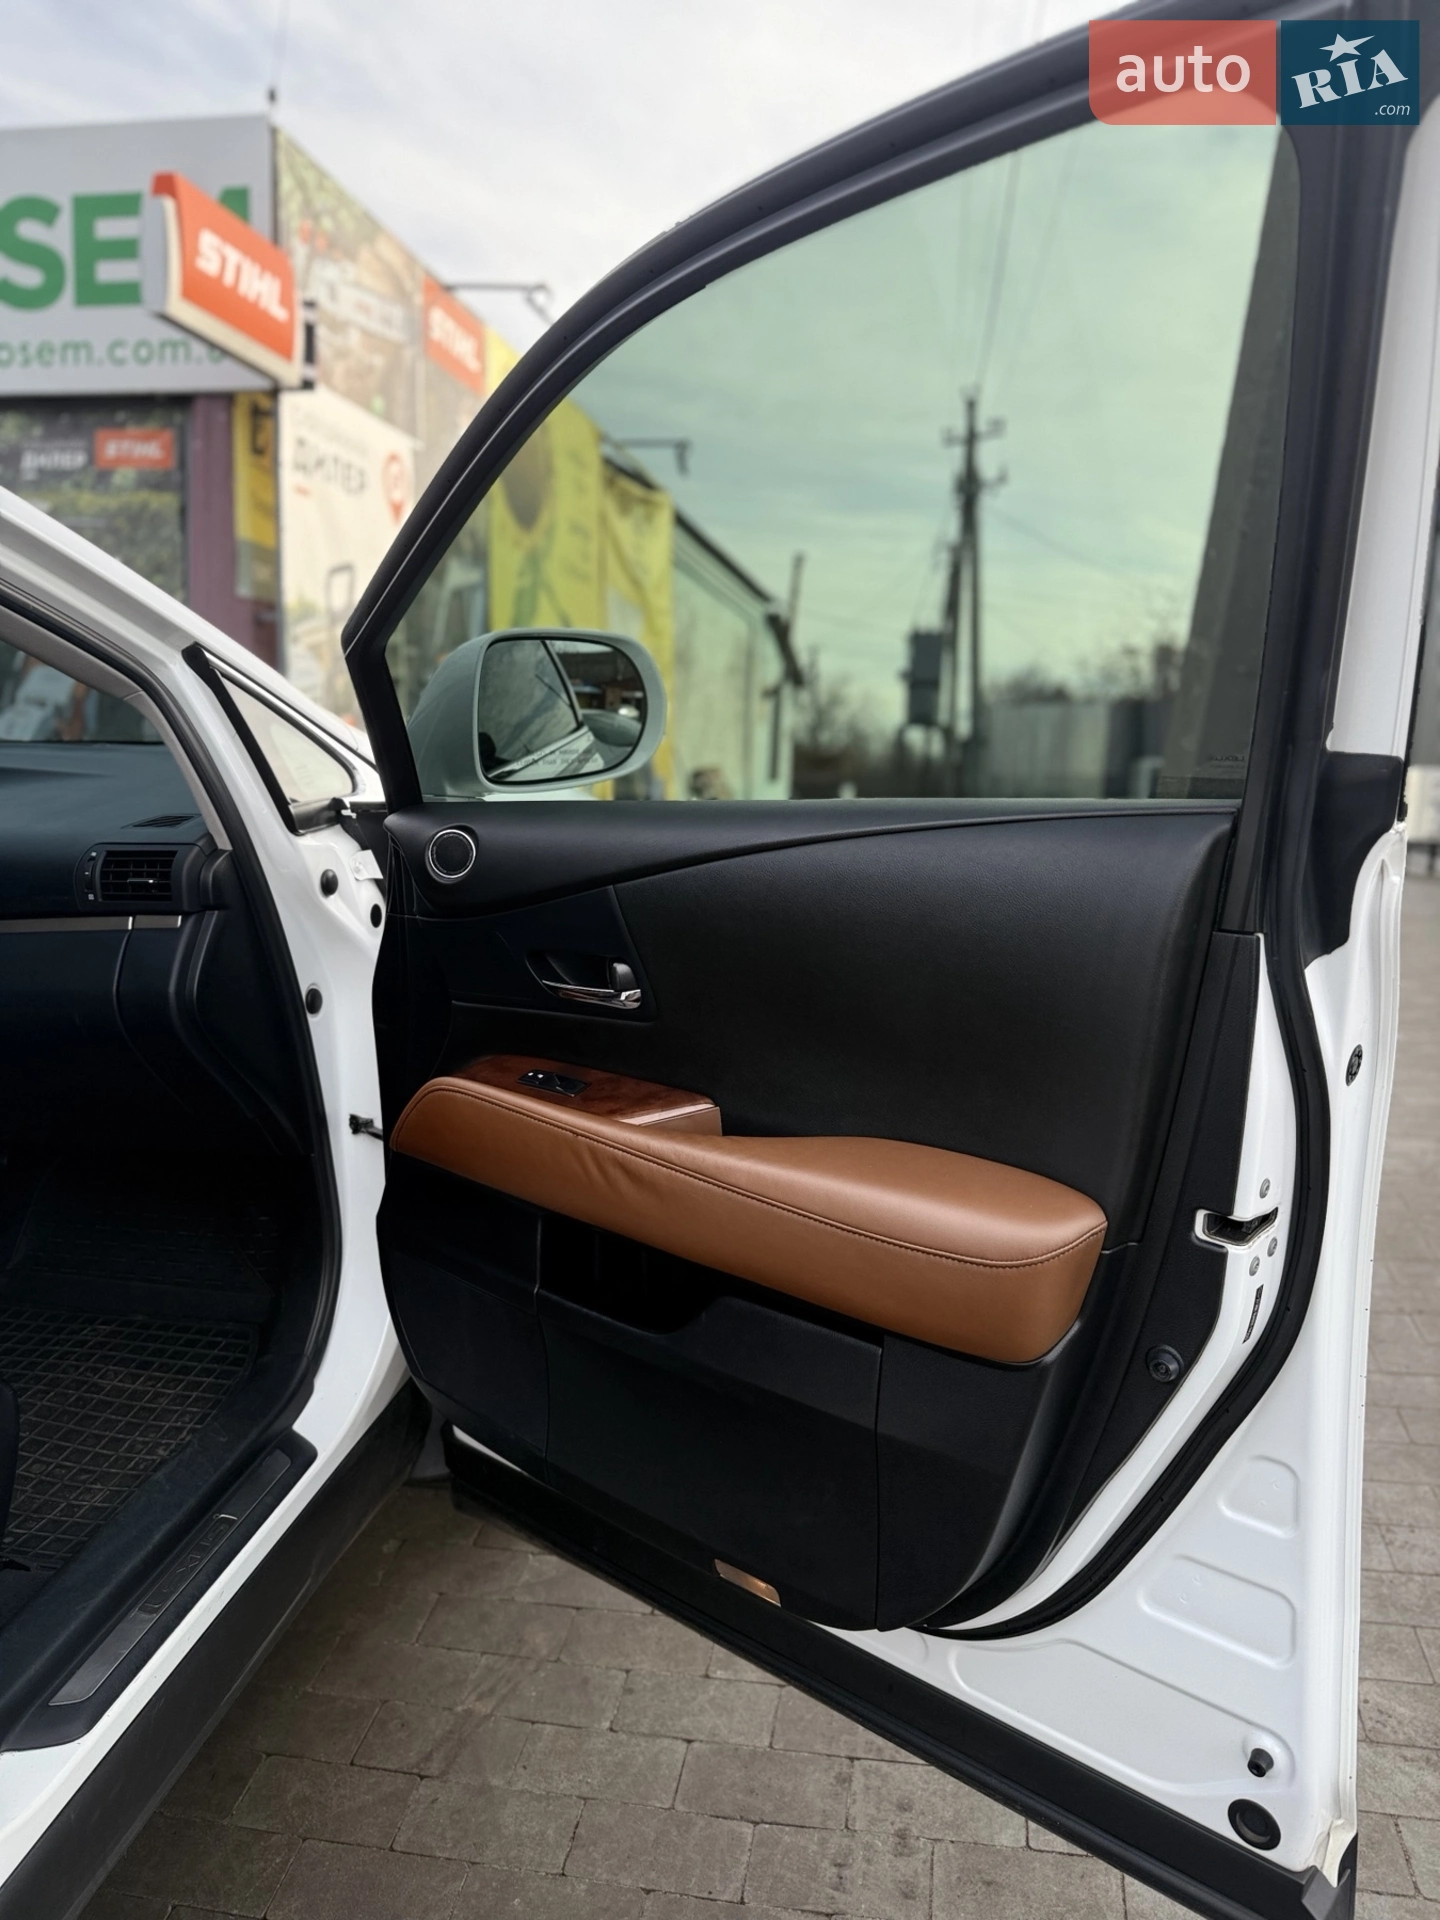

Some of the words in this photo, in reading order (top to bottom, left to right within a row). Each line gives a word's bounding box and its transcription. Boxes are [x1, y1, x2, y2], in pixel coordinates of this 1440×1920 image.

[0, 186, 251, 311] SE
[193, 227, 291, 322] STIHL
[428, 304, 482, 374] STIHL
